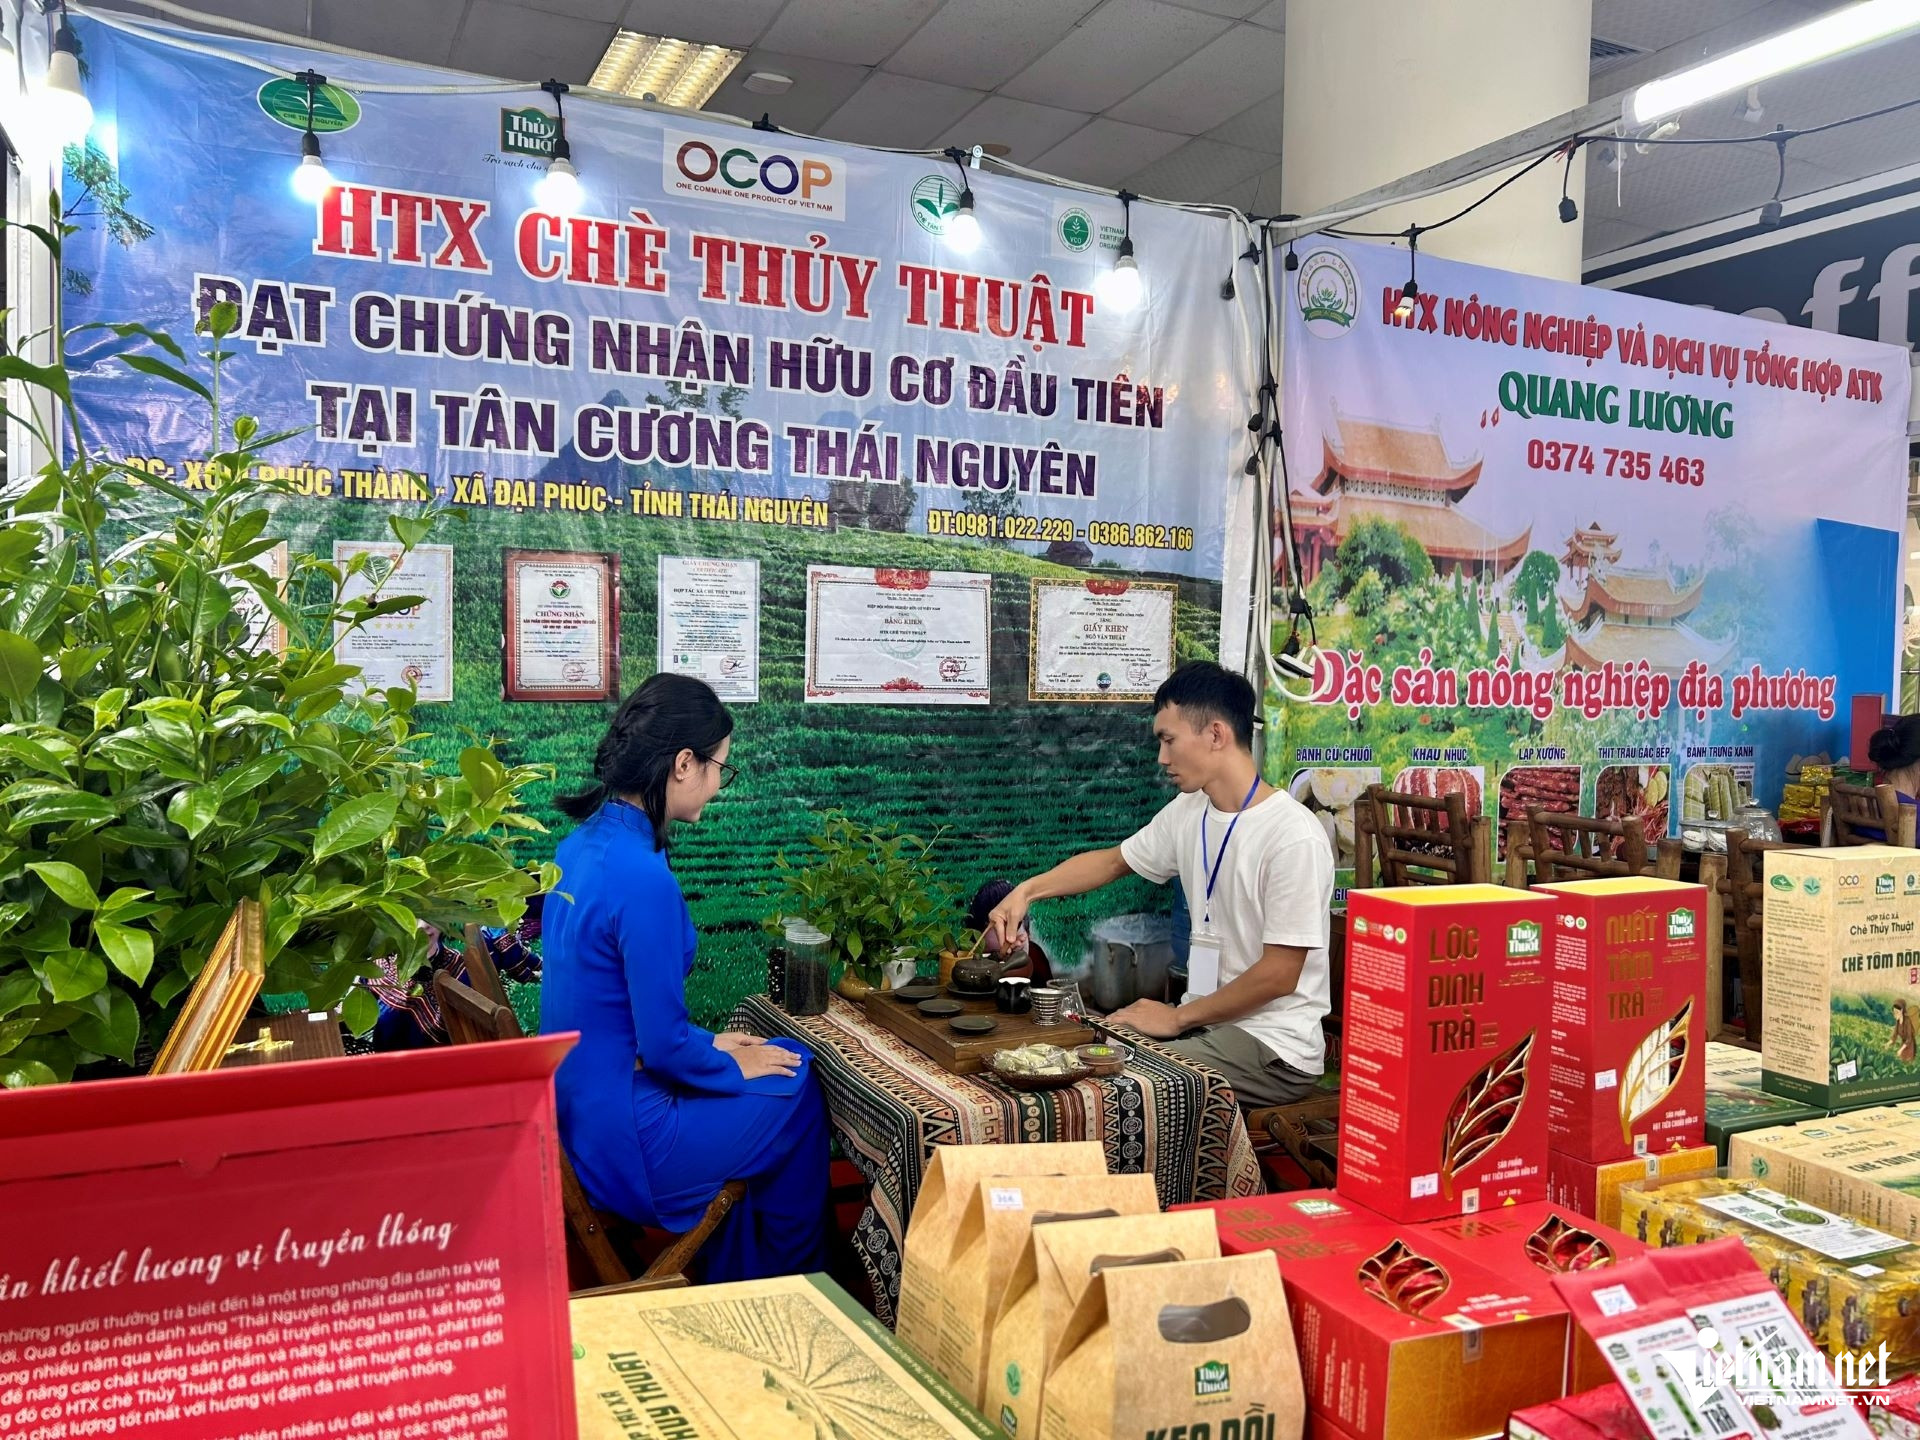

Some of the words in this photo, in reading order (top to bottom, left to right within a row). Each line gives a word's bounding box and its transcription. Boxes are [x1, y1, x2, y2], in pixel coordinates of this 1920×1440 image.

[510, 114, 555, 140] Thủy
[676, 141, 833, 199] OCOP
[676, 182, 692, 191] ONE
[694, 184, 732, 197] COMMUNE
[734, 191, 750, 199] ONE
[751, 193, 786, 205] PRODUCT
[799, 200, 815, 209] VIET
[816, 203, 833, 212] NAM
[317, 185, 488, 271] HTX
[516, 208, 669, 292] CHÈ
[693, 233, 879, 319] THỦY
[899, 265, 1094, 352] THUẬT
[193, 276, 333, 354] ĐẠT
[354, 294, 571, 367] CHỨNG
[592, 320, 752, 392] NHẬN
[770, 337, 873, 397] HỮU
[889, 352, 956, 404] CƠ
[966, 352, 1057, 416] ĐẦU
[1071, 373, 1164, 428] TIÊN
[1444, 293, 1518, 346] NÔNG
[1523, 311, 1613, 368] NGHIỆP
[1617, 322, 1648, 367] VÀ
[1653, 333, 1704, 380] DỊCH
[1710, 343, 1740, 389] VỤ
[1743, 339, 1799, 391] TỔNG
[1802, 357, 1843, 403] HỢP
[1846, 367, 1883, 404] ATK
[1498, 370, 1621, 425] QUANG
[1628, 387, 1735, 439] LƯƠNG
[310, 384, 413, 456] TẠI
[434, 388, 559, 457] TÂN
[577, 408, 769, 471] CƯƠNG
[788, 421, 900, 481] THÁI
[919, 438, 1097, 498] NGUYÊN
[1527, 438, 1595, 475] 0374
[1603, 447, 1652, 481] 735
[1658, 455, 1705, 487] 463
[341, 467, 428, 502] THÀNH
[452, 472, 487, 505] XÃ
[494, 479, 536, 512] ĐẠI
[544, 480, 607, 513] PHÚC
[631, 481, 682, 517] TỈNH
[691, 488, 738, 521] THÁI
[744, 494, 829, 527] NGUYÊN
[928, 509, 1074, 542] ĐT:0981.022.229
[1088, 522, 1194, 551] 0386.862.166
[1083, 622, 1103, 633] GIẤY
[1105, 624, 1129, 634] KHEN
[1311, 649, 1383, 720] Đặc
[1391, 647, 1458, 708] sản
[1467, 654, 1555, 721] nông
[1562, 658, 1671, 721] nghiệp
[1677, 659, 1724, 721] địa
[1731, 663, 1837, 722] phương
[1606, 905, 1658, 945] NHẤT
[1850, 924, 1868, 936] Chè
[1870, 921, 1889, 935] Thủy
[1891, 920, 1914, 934] Thuật
[1879, 912, 1890, 921] TÁC
[1891, 911, 1900, 920] XÃ
[1429, 922, 1479, 967] LỘC
[1842, 953, 1864, 973] CHÈ
[1608, 985, 1645, 1022] TRÀ
[1428, 1008, 1476, 1055] TRÀ
[41, 1250, 128, 1295] khiết
[133, 1245, 230, 1284] hương
[236, 1243, 272, 1271] vị
[274, 1227, 370, 1267] truyền
[376, 1211, 460, 1250] thống
[301, 1281, 339, 1302] trong
[415, 1265, 451, 1283] danh
[474, 1257, 501, 1275] Việt
[23, 1342, 57, 1362] Qua
[146, 1323, 186, 1344] danh
[271, 1301, 329, 1327] Nguyên
[388, 1288, 425, 1307] danh
